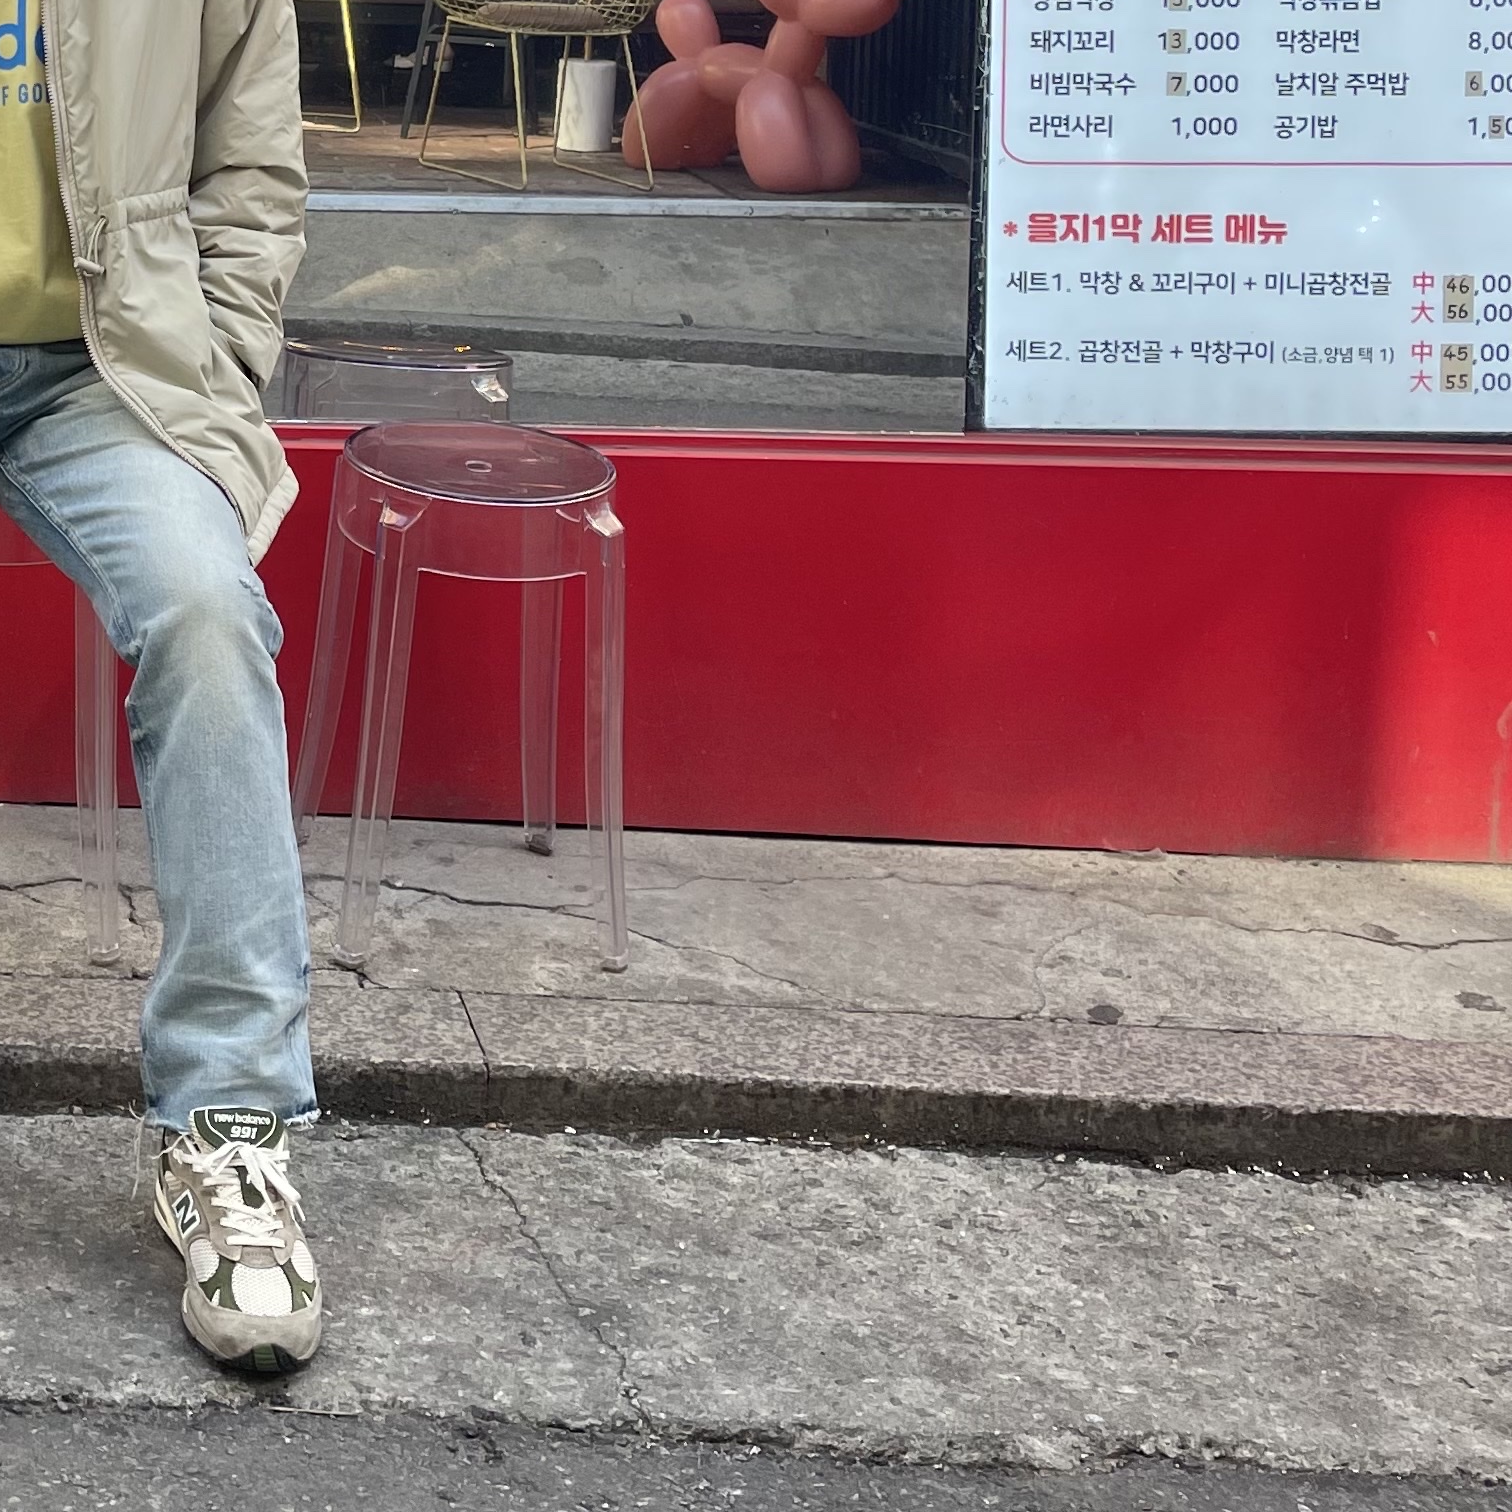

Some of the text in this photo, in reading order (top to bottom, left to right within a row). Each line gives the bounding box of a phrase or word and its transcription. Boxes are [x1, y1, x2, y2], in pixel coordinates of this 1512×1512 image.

[1029, 30, 1240, 55] 돼지꼬리 13,000
[1276, 29, 1361, 54] 막창라면
[1029, 73, 1239, 97] 비빔막국수 7,000
[1275, 73, 1340, 96] 날치알
[1344, 73, 1410, 96] 주먹밥
[1028, 116, 1238, 140] 라면사리 1,000
[1274, 116, 1338, 140] 공기밥
[1027, 212, 1288, 245] 을지1막 세트 메뉴
[1006, 272, 1071, 294] 세트1.
[1079, 271, 1122, 295] 막창
[1129, 273, 1145, 293] &
[1151, 271, 1236, 295] 꼬리구이
[1264, 271, 1392, 296] 미니곱창전골
[1413, 271, 1434, 295] 中
[1411, 300, 1435, 323] 大
[1005, 341, 1070, 363] 세트2.
[1078, 340, 1163, 364] 곱창전골
[1190, 340, 1275, 364] 막창구이
[1357, 346, 1374, 364] 택
[1379, 347, 1395, 364] 1)
[1411, 340, 1432, 364] 中
[1410, 370, 1433, 393] 大
[214, 1113, 271, 1126] new balance
[230, 1125, 258, 1140] 991
